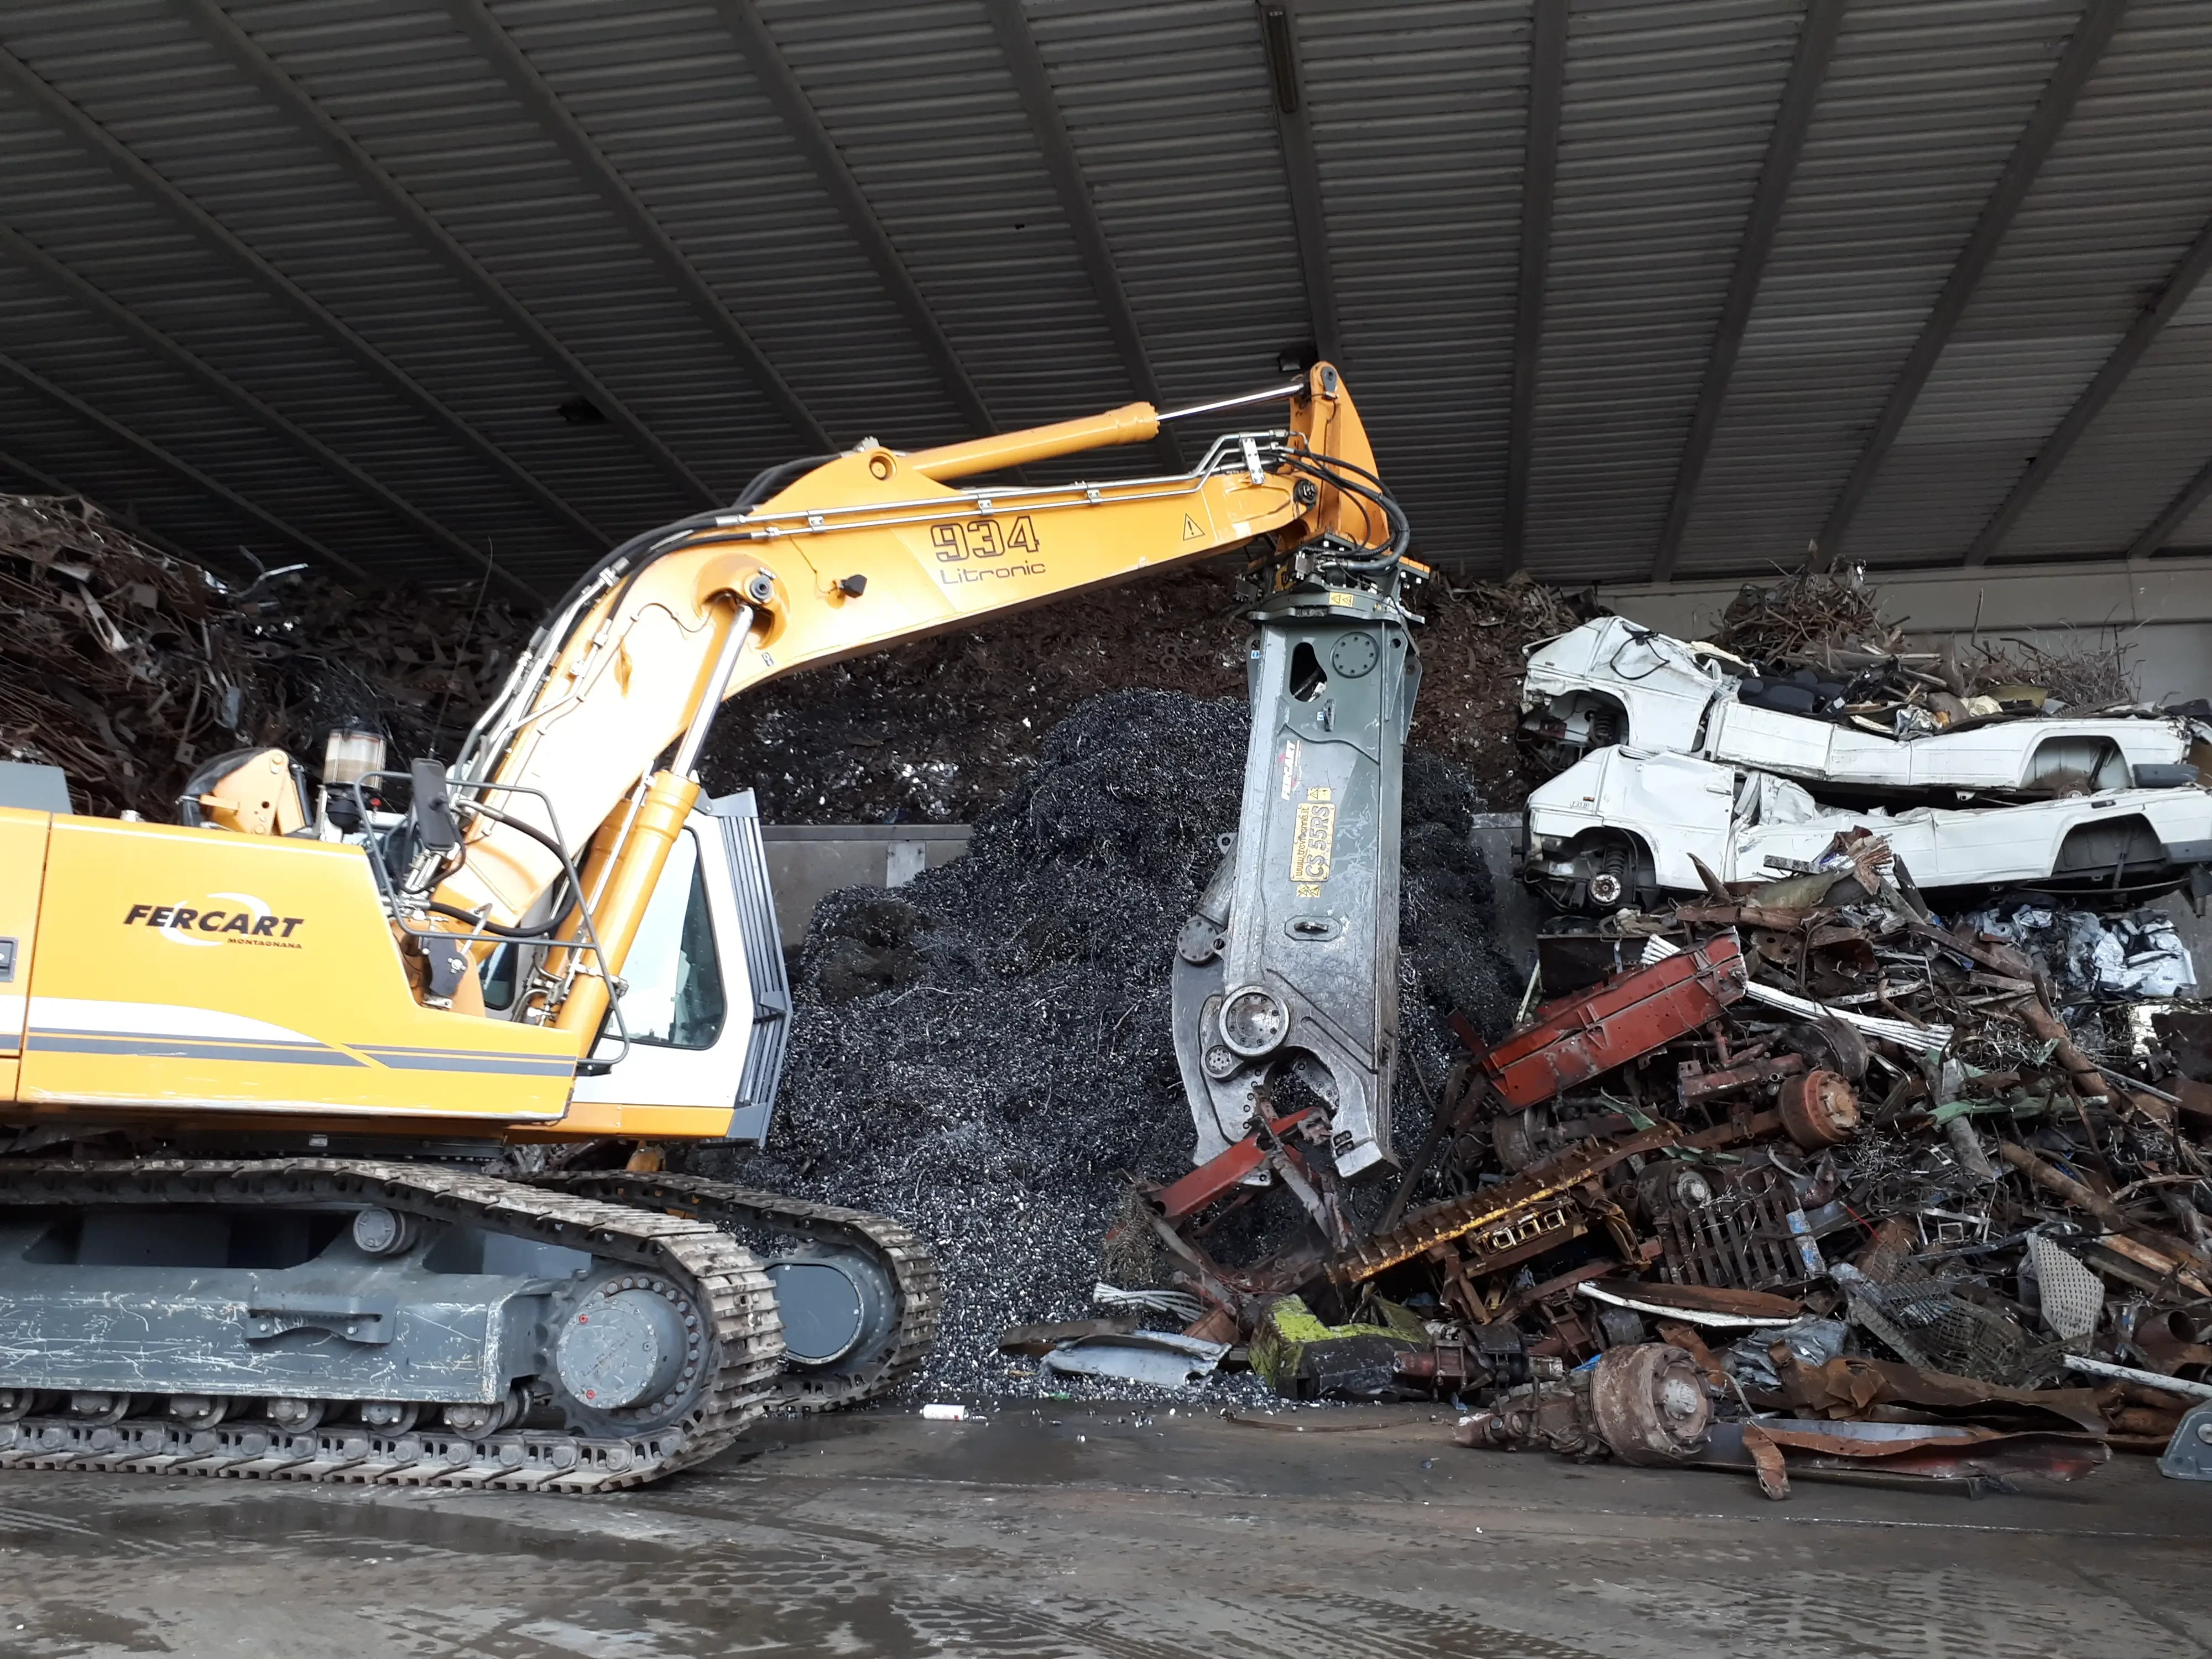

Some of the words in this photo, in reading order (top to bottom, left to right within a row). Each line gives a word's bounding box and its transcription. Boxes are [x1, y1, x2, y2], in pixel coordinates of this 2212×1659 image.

[930, 515, 1040, 562] 934
[940, 560, 1046, 585] Litronic
[1308, 805, 1331, 851] 55RS
[1305, 854, 1326, 878] CS
[123, 903, 305, 938] FERCART
[227, 937, 303, 950] MONTAGNANA
